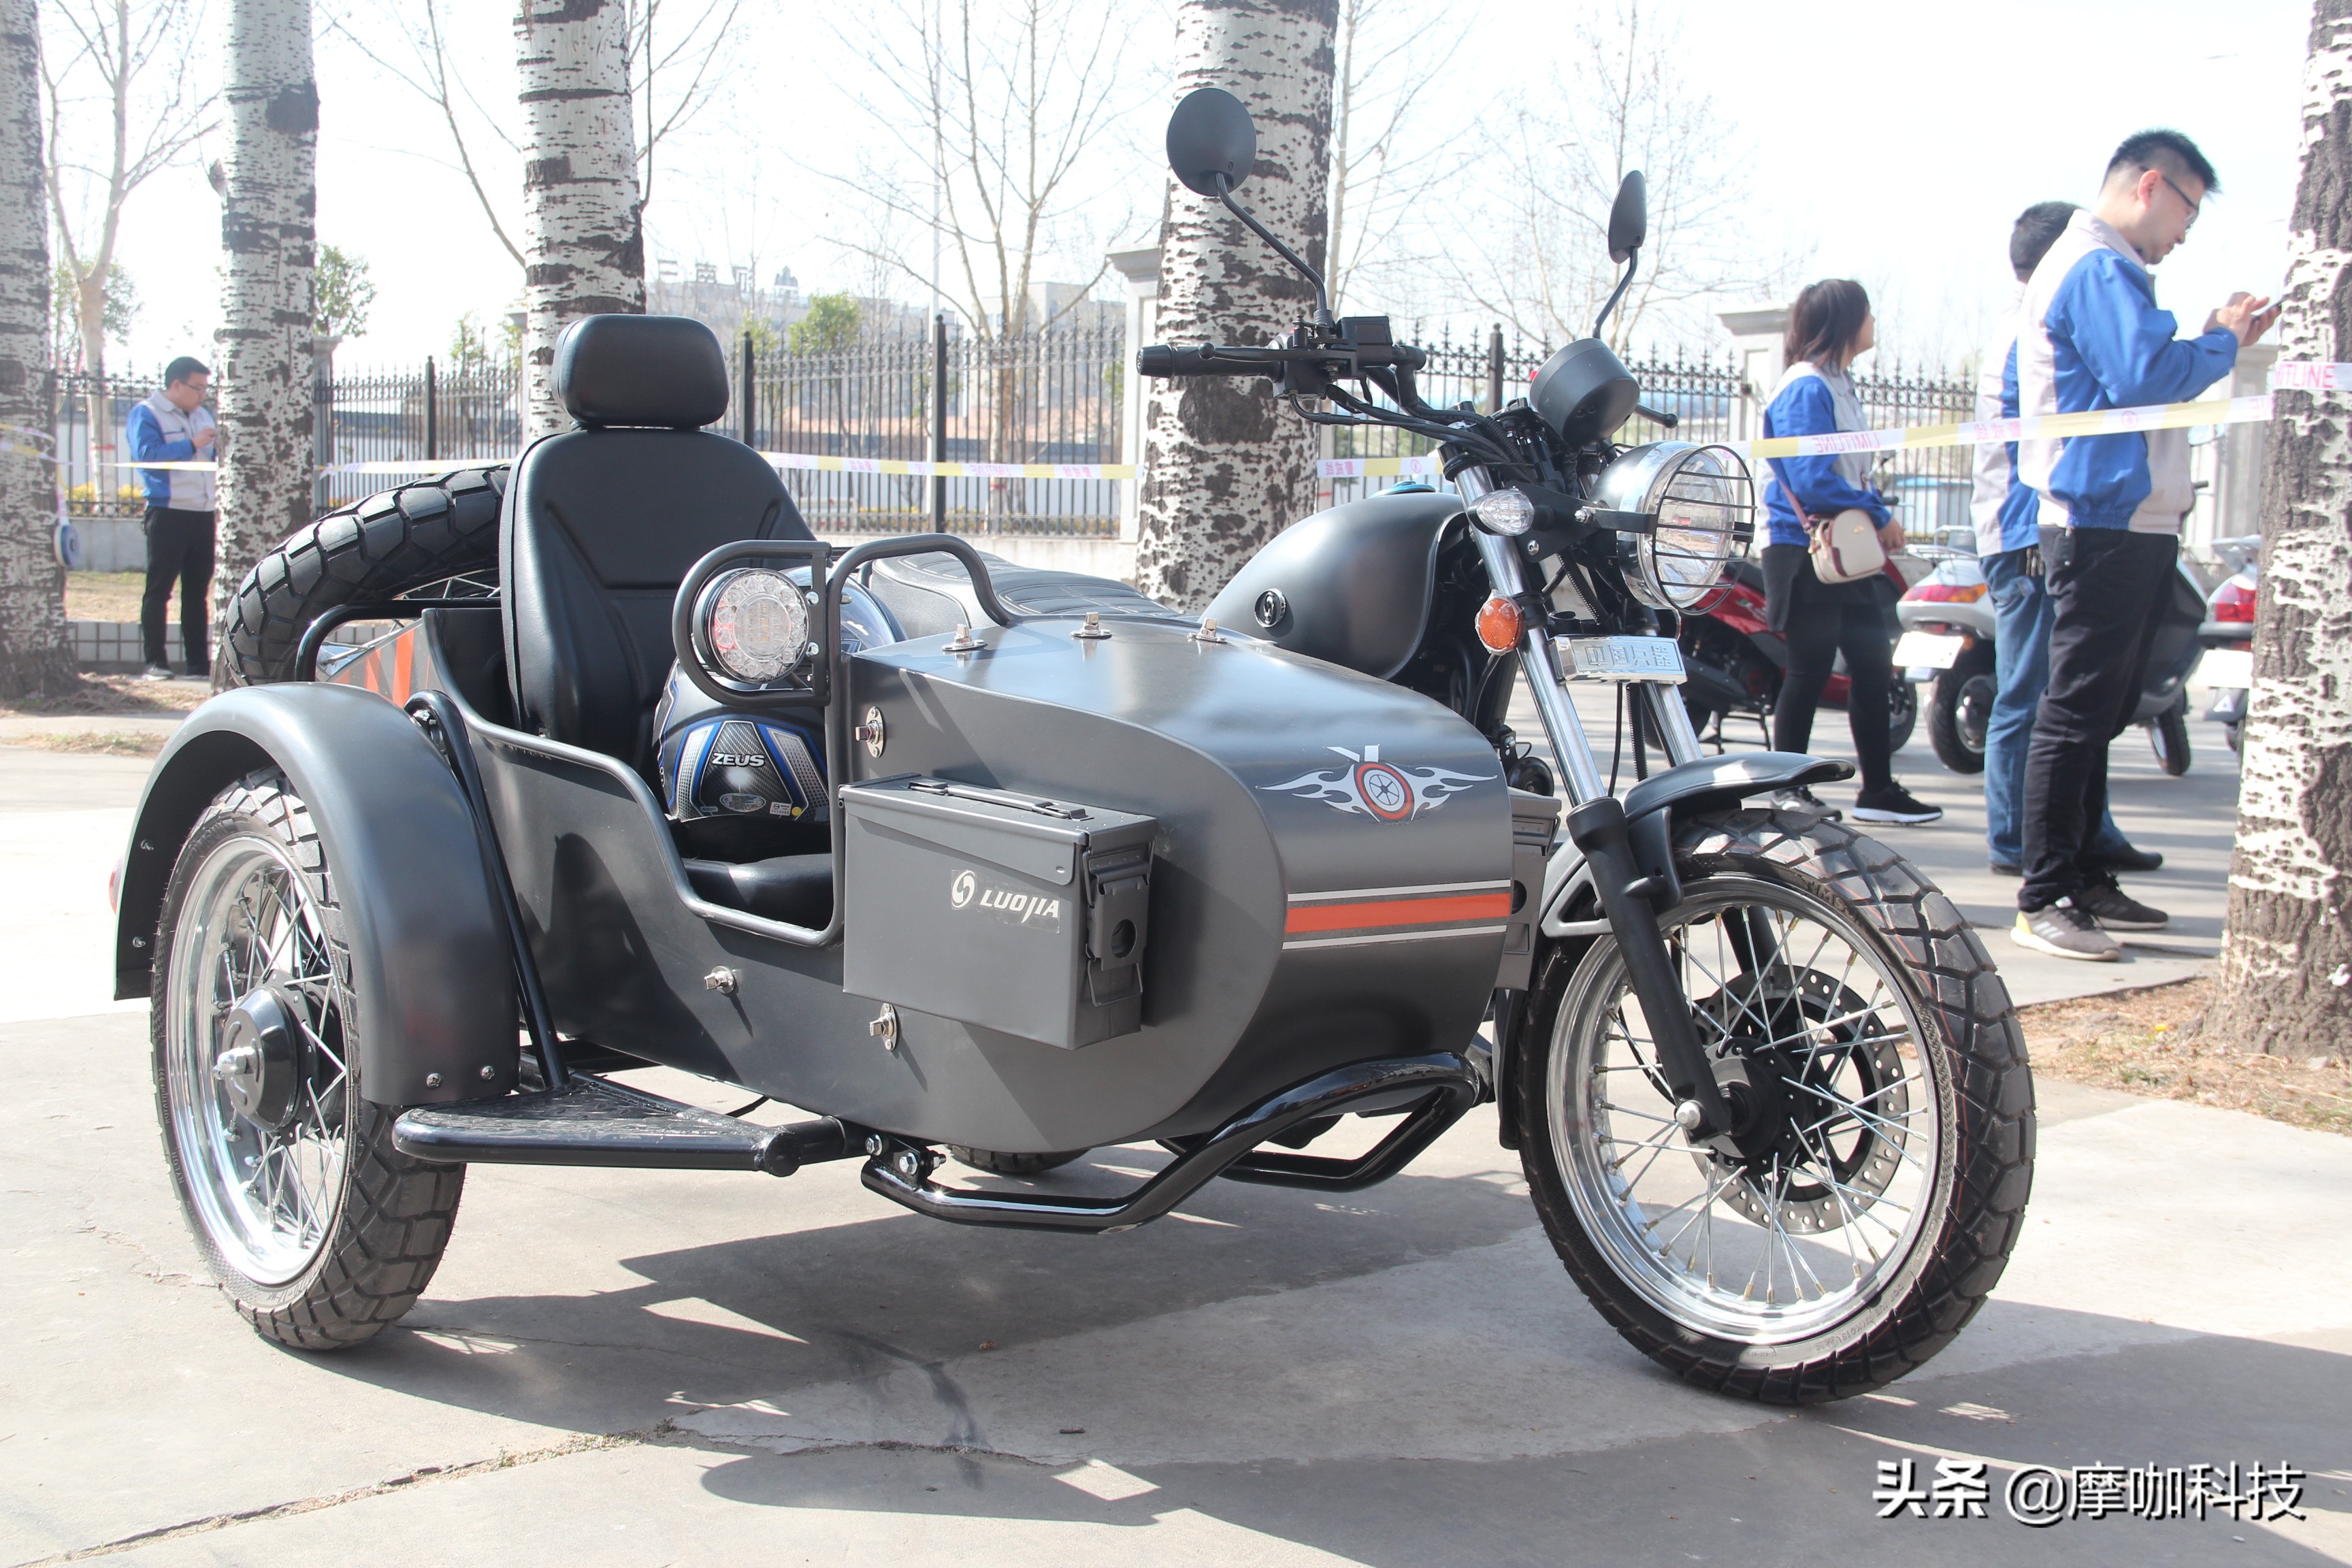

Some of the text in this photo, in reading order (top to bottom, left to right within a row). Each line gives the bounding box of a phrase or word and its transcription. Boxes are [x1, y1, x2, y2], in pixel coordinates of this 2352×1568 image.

[1584, 644, 1673, 668] 中国兵器
[712, 752, 766, 767] ZEUS
[979, 889, 1060, 924] LUOJIA
[170, 1151, 184, 1184] NYLON
